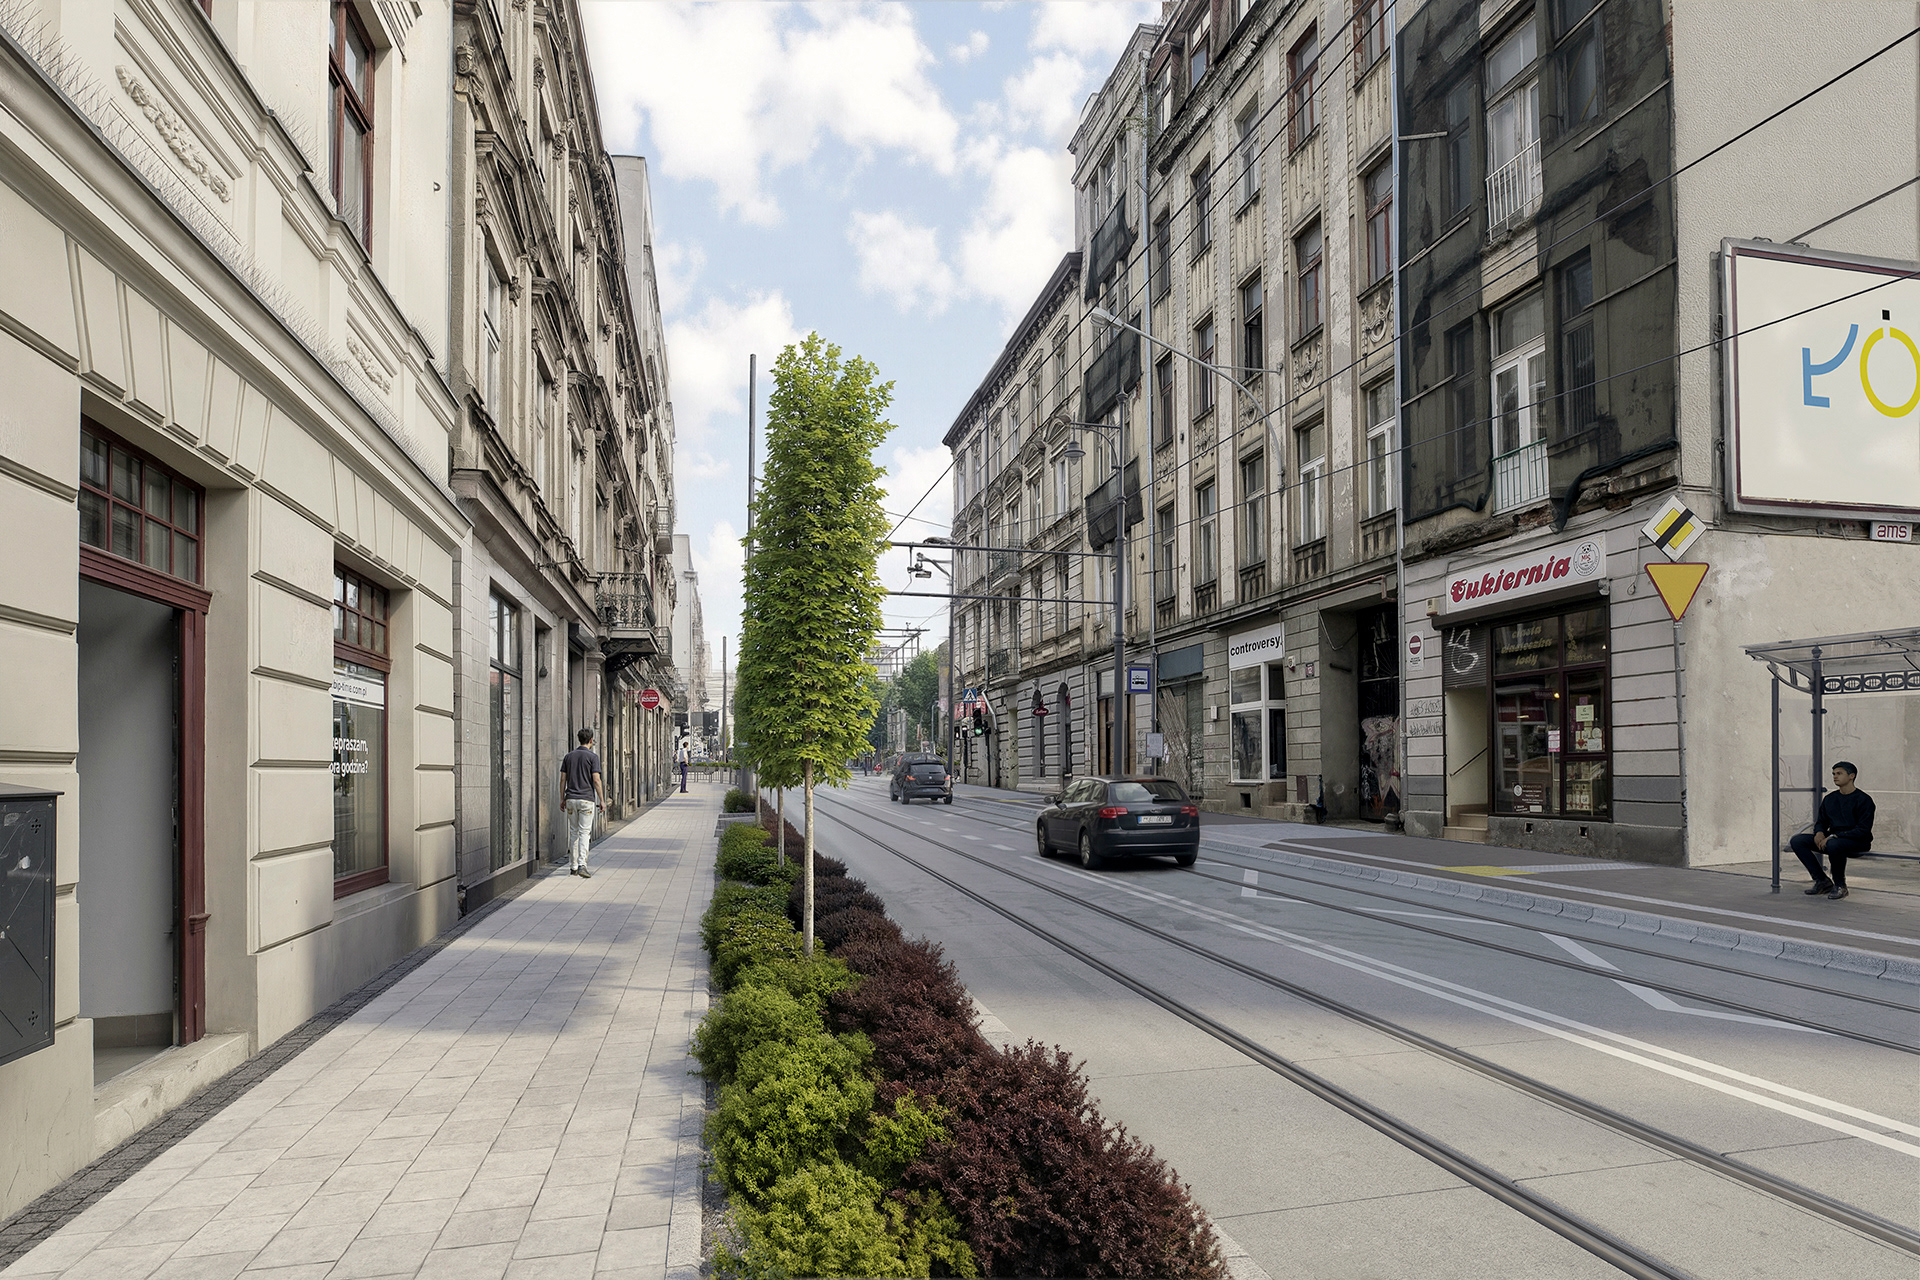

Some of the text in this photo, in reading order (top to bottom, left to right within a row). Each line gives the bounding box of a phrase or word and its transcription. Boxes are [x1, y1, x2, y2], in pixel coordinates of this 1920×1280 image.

[1877, 525, 1907, 538] ams
[1450, 555, 1571, 603] Cukiernia
[1230, 636, 1283, 656] controversy.
[1515, 654, 1539, 666] lody
[332, 737, 368, 754] epraszam,
[341, 759, 368, 777] godzina?
